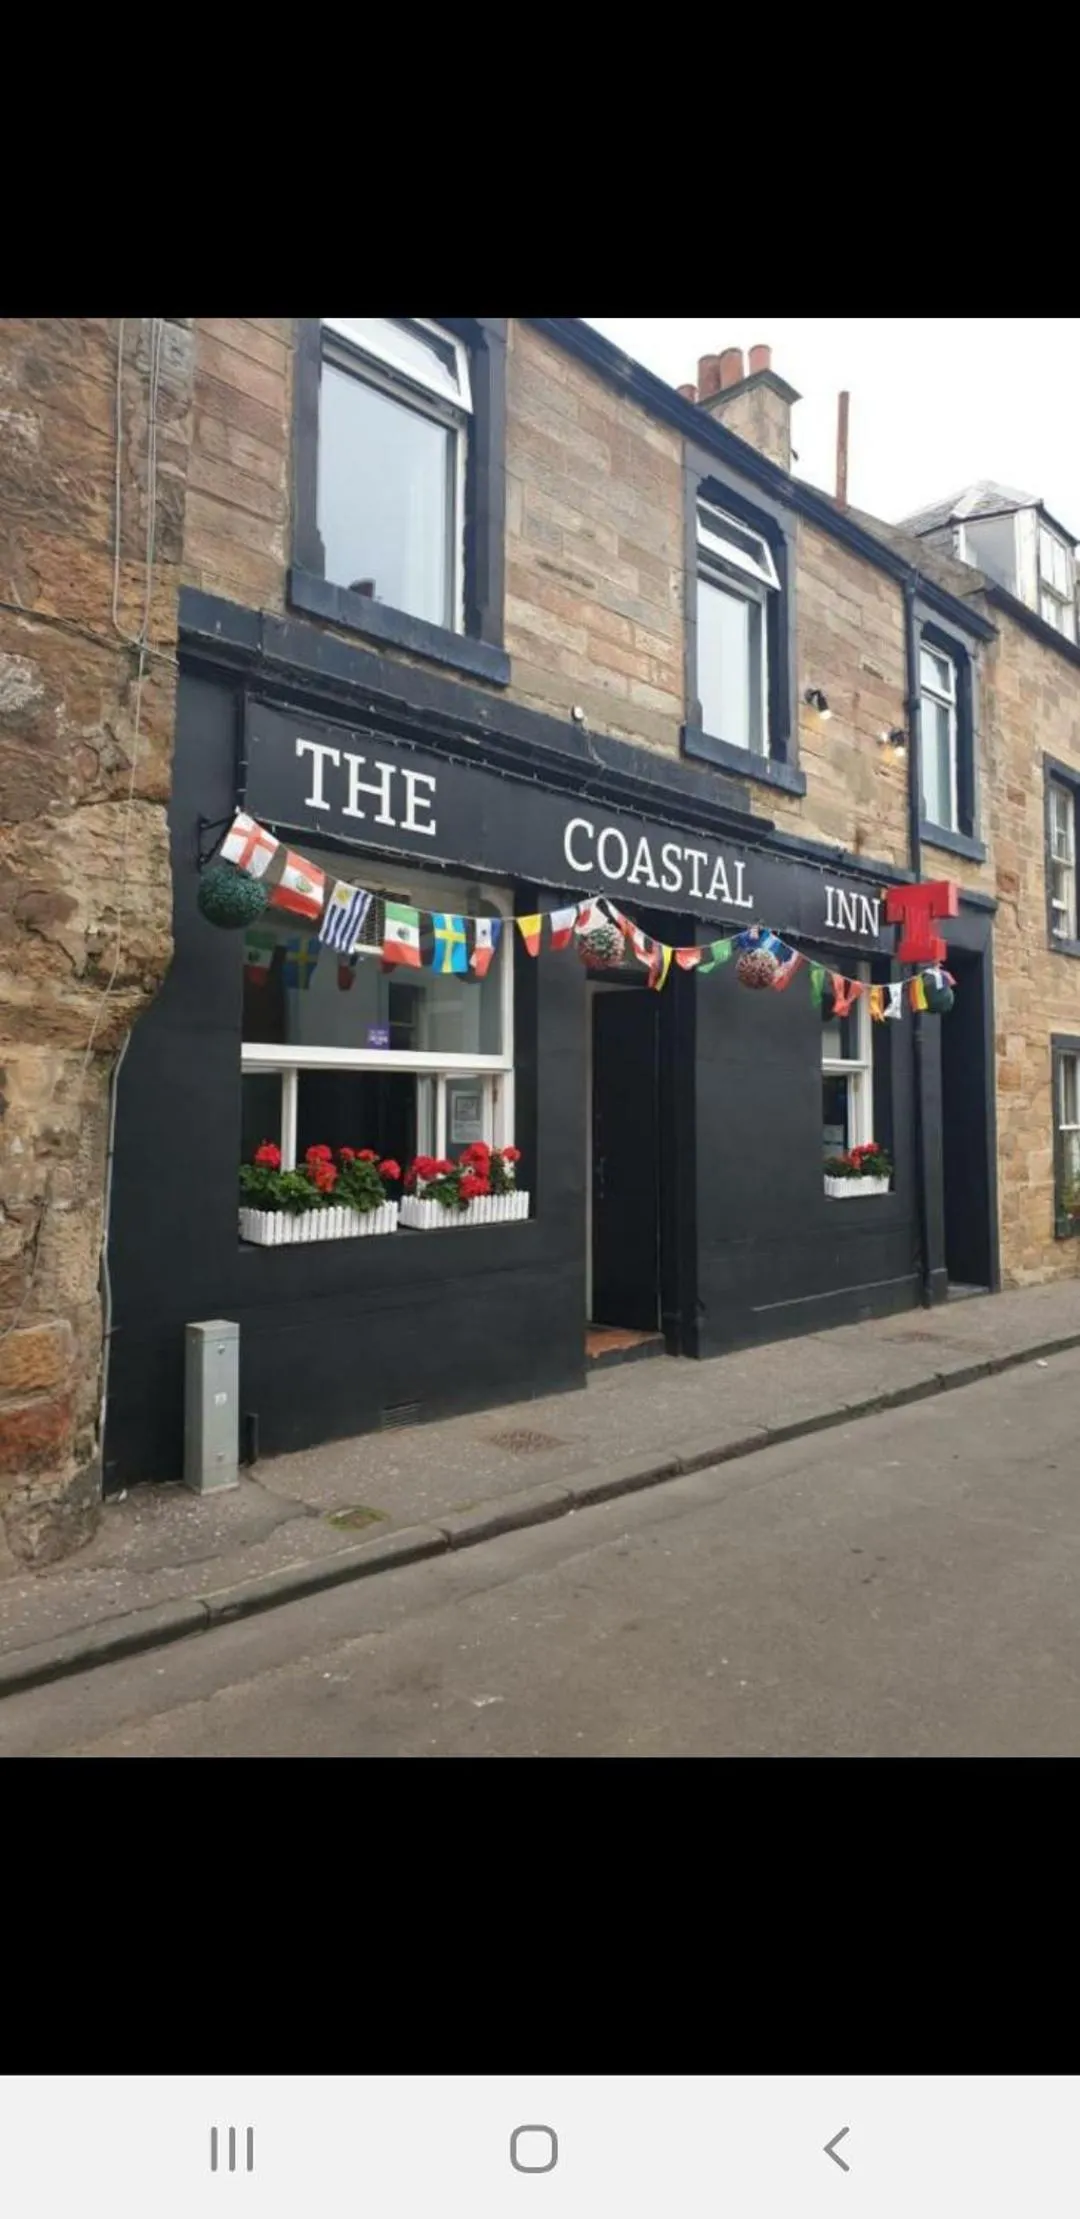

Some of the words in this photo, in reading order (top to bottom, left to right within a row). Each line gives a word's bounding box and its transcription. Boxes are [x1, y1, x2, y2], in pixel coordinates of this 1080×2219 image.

[296, 738, 437, 836] THE
[563, 818, 754, 909] COASTAL
[824, 885, 881, 938] INN
[886, 880, 959, 963] T
